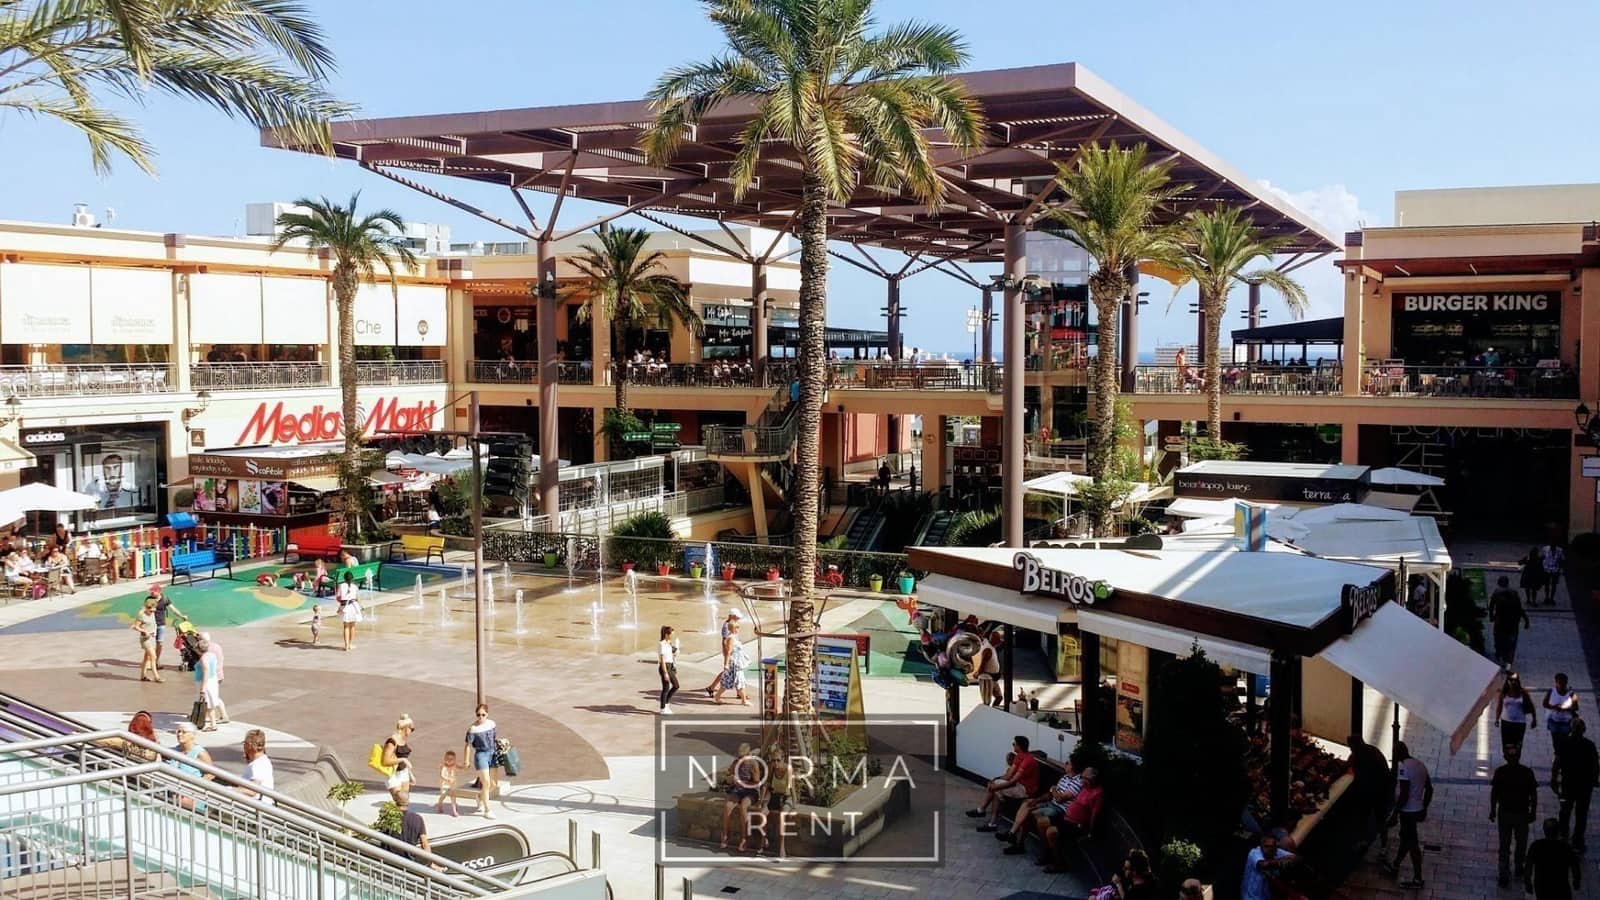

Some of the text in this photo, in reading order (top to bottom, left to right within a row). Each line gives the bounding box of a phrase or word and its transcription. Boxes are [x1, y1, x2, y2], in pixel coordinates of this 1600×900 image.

[1404, 294, 1548, 311] BURGER KING
[234, 397, 438, 446] Media Markt
[26, 430, 66, 443] adidas
